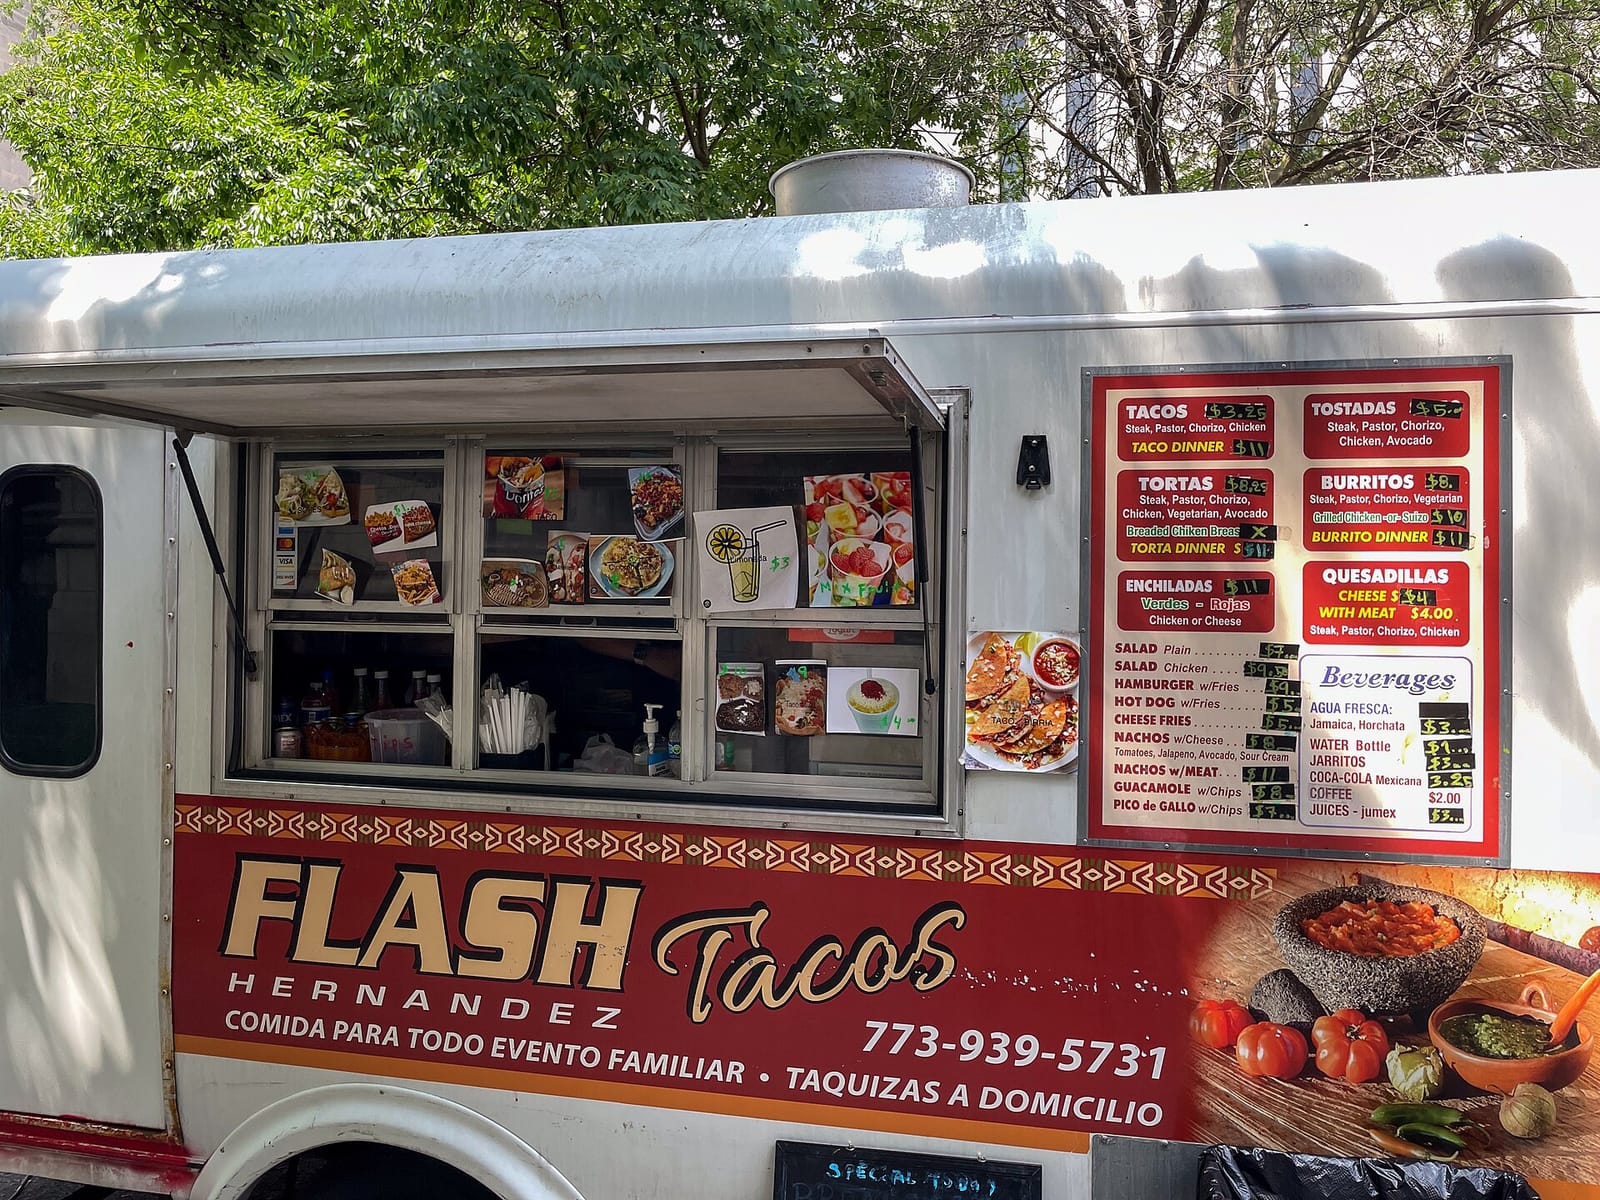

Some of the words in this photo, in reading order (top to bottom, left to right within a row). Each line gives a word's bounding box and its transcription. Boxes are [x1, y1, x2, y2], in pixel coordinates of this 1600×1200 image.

[1126, 404, 1188, 419] TACOS
[1312, 401, 1396, 416] TOSTADAS
[1125, 424, 1153, 433] Steak,
[1155, 424, 1186, 433] Pastor,
[1189, 423, 1226, 433] Chorizo,
[1229, 422, 1266, 432] Chicken
[1327, 422, 1359, 433] Steak,
[1362, 422, 1398, 432] Pastor,
[1401, 420, 1445, 432] Chorizo,
[1132, 442, 1168, 453] TACO
[1172, 441, 1224, 452] DINNER
[1339, 436, 1384, 447] Chicken,
[1387, 435, 1432, 445] Avocado
[1139, 477, 1213, 491] TORTAS
[1321, 475, 1414, 489] BURRITOS
[505, 486, 544, 503] Doritos
[1140, 495, 1169, 506] Steak,
[1172, 495, 1206, 506] Pastor,
[1209, 495, 1250, 505] Chorizo,
[1310, 495, 1337, 505] Steak,
[1340, 495, 1371, 505] Pastor,
[1374, 494, 1411, 505] Chorizo,
[1414, 494, 1462, 505] Vegetarian
[1123, 509, 1165, 520] Chicken,
[1167, 509, 1222, 520] Vegetarian,
[1225, 508, 1268, 518] Avocado
[1313, 512, 1343, 523] Grilled
[1345, 512, 1381, 523] Chicken
[1403, 512, 1428, 522] Suizo
[1127, 526, 1169, 537] Breaded
[1171, 525, 1207, 537] Chiken
[1210, 525, 1240, 537] Breas
[1312, 531, 1372, 542] BURRITO
[1376, 531, 1428, 542] DINNER
[1131, 543, 1172, 554] TORTA
[1176, 543, 1225, 554] DINNER
[769, 557, 790, 572] $3
[1322, 569, 1449, 584] QUESADILLAS
[1126, 580, 1212, 592] ENCHILADAS
[1339, 590, 1386, 602] CHEESE
[1141, 598, 1189, 610] Verdes
[1210, 598, 1250, 612] Rojas
[1319, 607, 1355, 618] WITH
[1358, 607, 1396, 619] MEAT
[1411, 607, 1453, 620] $4.00
[1149, 616, 1189, 625] Chicken
[1192, 617, 1202, 625] or
[1205, 616, 1242, 626] Cheese
[1310, 625, 1339, 636] Steak,
[1342, 626, 1375, 636] Pastor,
[1378, 626, 1417, 637] Chorizo,
[1420, 626, 1460, 636] Chicken
[1115, 643, 1157, 653] SALAD
[1164, 645, 1191, 655] Plain
[1115, 661, 1157, 671] SALAD
[1164, 663, 1208, 673] Chicken
[1115, 679, 1194, 690] HAMBURGER
[1200, 682, 1239, 692] w/Fries
[1320, 665, 1456, 695] Beverages
[1115, 696, 1142, 707] HOT
[1146, 697, 1175, 708] DOG
[1181, 700, 1220, 709] w/Fries
[1310, 702, 1341, 714] AGUA
[1345, 703, 1392, 714] FRESCA:
[1115, 714, 1156, 725] CHEESE
[1160, 715, 1191, 726] FRIES
[1310, 719, 1355, 731] Jamaica,
[1359, 720, 1405, 731] Horchata
[1115, 732, 1170, 743] NACHOS
[1174, 735, 1223, 745] w/Cheese
[1310, 739, 1348, 750] WATER
[1356, 740, 1390, 751] Bottle
[1115, 747, 1155, 758] Tomatoes,
[1158, 751, 1196, 759] Jalapeno,
[1199, 751, 1237, 760] Avocado,
[1240, 751, 1260, 761] Sour
[1262, 752, 1289, 761] Cream
[1310, 755, 1365, 767] JARRITOS
[1114, 764, 1166, 775] NACHOS
[1169, 766, 1218, 778] w/MEAT
[1310, 772, 1372, 784] COCA-COLA
[1376, 775, 1421, 786] Mexicana
[1114, 782, 1191, 794] GUACAMOLE
[1198, 787, 1241, 797] w/Chips
[1310, 787, 1352, 800] COFFEE
[1429, 792, 1460, 804] $2.00
[1114, 799, 1140, 810] PICO
[1143, 800, 1156, 811] de
[1159, 801, 1195, 812] GALLO
[1198, 805, 1242, 815] w/Chips
[1310, 804, 1349, 816] JUICES
[1361, 806, 1396, 819] jumex
[219, 852, 644, 991] FLASH
[651, 900, 967, 1024] Tacos
[227, 972, 621, 1030] HERNANDEZ
[225, 1010, 326, 1039] COMIDA
[332, 1020, 399, 1046] PARA
[408, 1028, 483, 1055] TODO
[491, 1037, 601, 1068] EVENTO
[608, 1048, 745, 1083] FAMILIAR
[863, 1019, 1168, 1080] 773-939-5731
[787, 1067, 942, 1103] TAQUIZAS
[948, 1084, 970, 1107] A
[978, 1087, 1164, 1127] DOMICILIO
